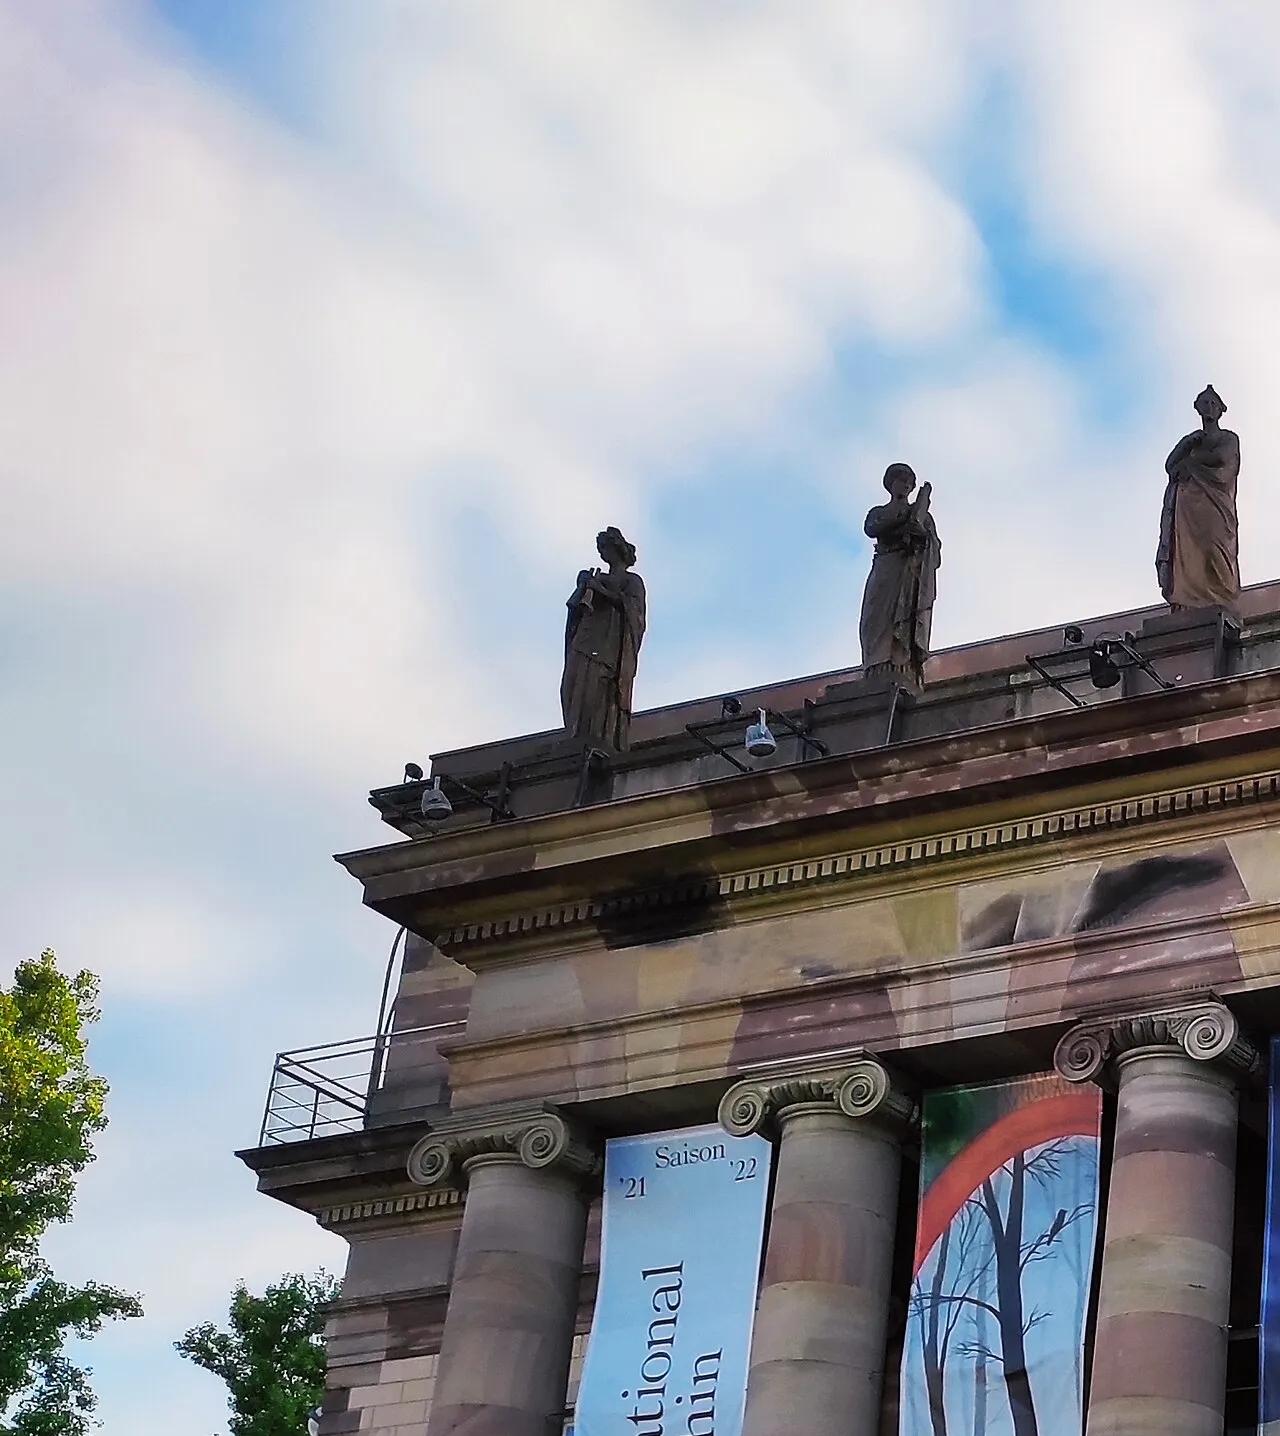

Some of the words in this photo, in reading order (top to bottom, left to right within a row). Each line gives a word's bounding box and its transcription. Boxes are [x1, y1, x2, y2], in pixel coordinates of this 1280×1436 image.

[655, 1142, 726, 1169] Saison
[729, 1157, 757, 1182] '22
[618, 1176, 647, 1199] '21
